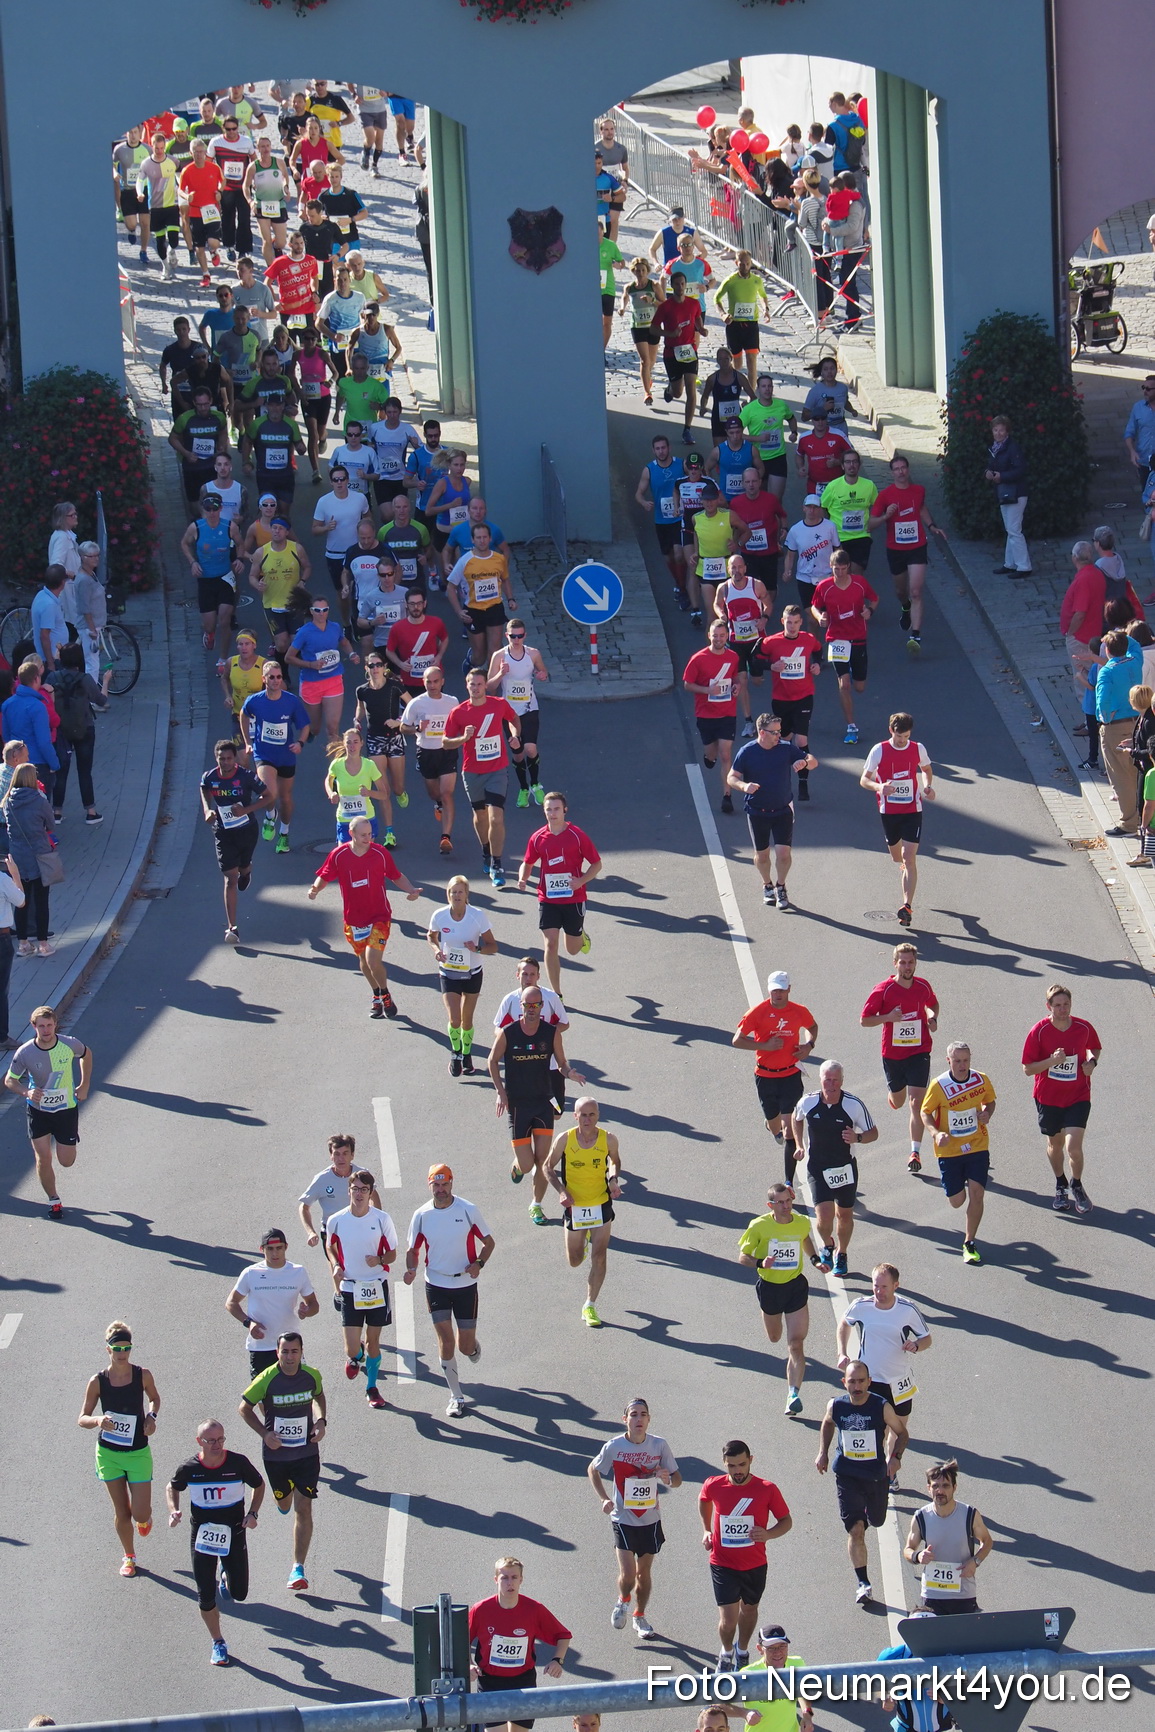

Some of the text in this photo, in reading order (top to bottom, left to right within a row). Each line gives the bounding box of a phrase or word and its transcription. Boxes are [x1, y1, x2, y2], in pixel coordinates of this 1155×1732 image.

[639, 311, 651, 319] 215
[305, 384, 316, 392] 206
[724, 406, 736, 414] 207
[189, 426, 217, 434] BOCK
[260, 434, 289, 442] BOCK
[382, 461, 398, 469] 2784
[454, 511, 466, 519] 350
[898, 527, 915, 535] 2465
[706, 563, 723, 571] 2367
[478, 584, 496, 593] 2246
[738, 625, 752, 634] 264
[832, 645, 845, 653] 262
[413, 661, 431, 670] 2620
[784, 662, 802, 671] 2619
[511, 686, 526, 694] 200
[431, 721, 445, 730] 247
[266, 728, 284, 737] 2635
[479, 741, 498, 751] 2614
[210, 789, 244, 797] MENSCH
[343, 800, 363, 810] 2616
[549, 879, 569, 889] 2455
[449, 952, 464, 962] 273
[899, 1027, 915, 1036] 263
[1053, 1061, 1075, 1071] 2467
[43, 1094, 64, 1105] 2220
[949, 1095, 968, 1108] MAX
[952, 1115, 974, 1127] 2415
[828, 1172, 848, 1185] 3061
[581, 1208, 592, 1218] 71
[773, 1248, 795, 1259] 2545
[360, 1287, 377, 1297] 304
[897, 1376, 911, 1391] 341
[272, 1390, 313, 1404] BOCK
[279, 1425, 303, 1435] 2535
[852, 1439, 865, 1449] 62
[202, 1486, 226, 1501] mr
[632, 1486, 651, 1497] 299
[724, 1523, 749, 1535] 2622
[202, 1530, 227, 1544] 2318
[933, 1569, 953, 1580] 216
[496, 1643, 522, 1655] 2487
